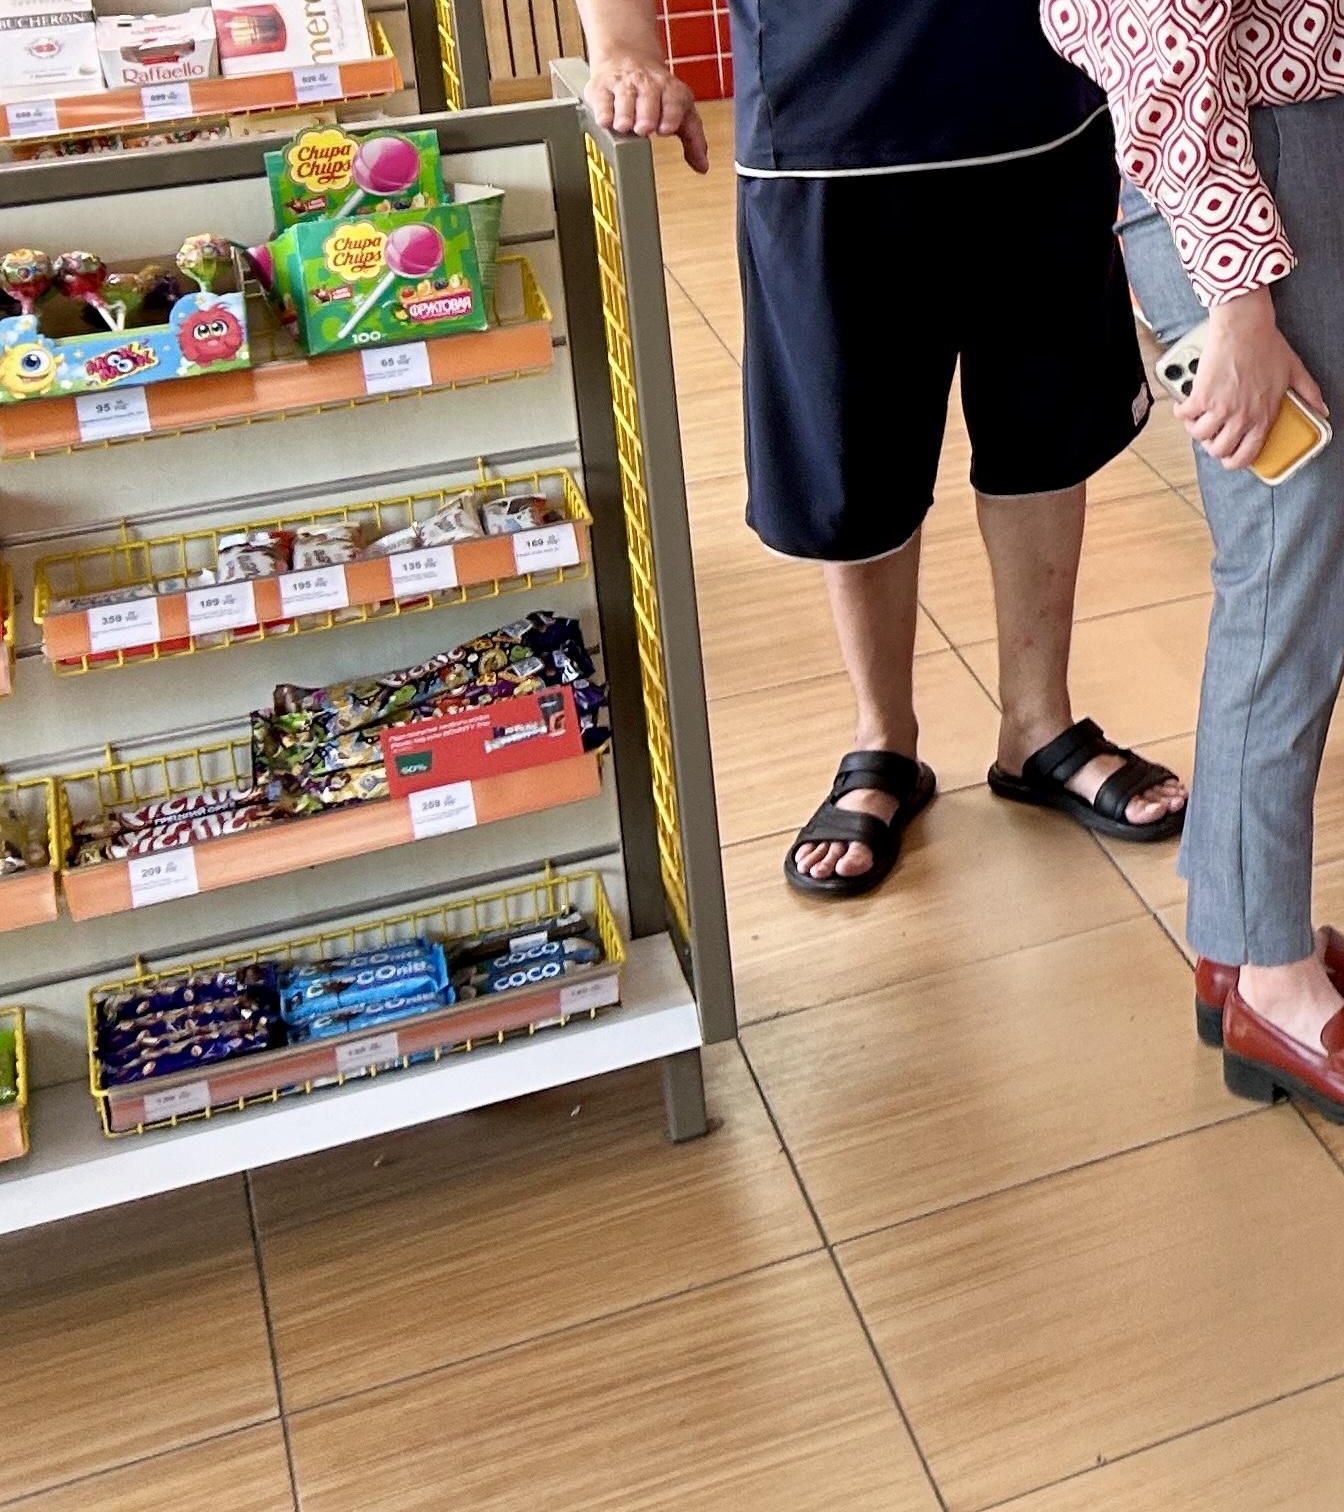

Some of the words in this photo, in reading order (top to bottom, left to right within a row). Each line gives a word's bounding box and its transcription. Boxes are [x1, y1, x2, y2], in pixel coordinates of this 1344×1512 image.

[122, 59, 205, 85] Raffaello
[298, 143, 352, 162] Chupa
[298, 159, 352, 178] Chups
[333, 237, 381, 254] Chupa
[333, 250, 382, 268] Chups
[409, 294, 473, 318] ФРУКТОВАЯ
[352, 330, 381, 345] 100
[95, 402, 112, 414] 95
[493, 961, 561, 991] COCO
